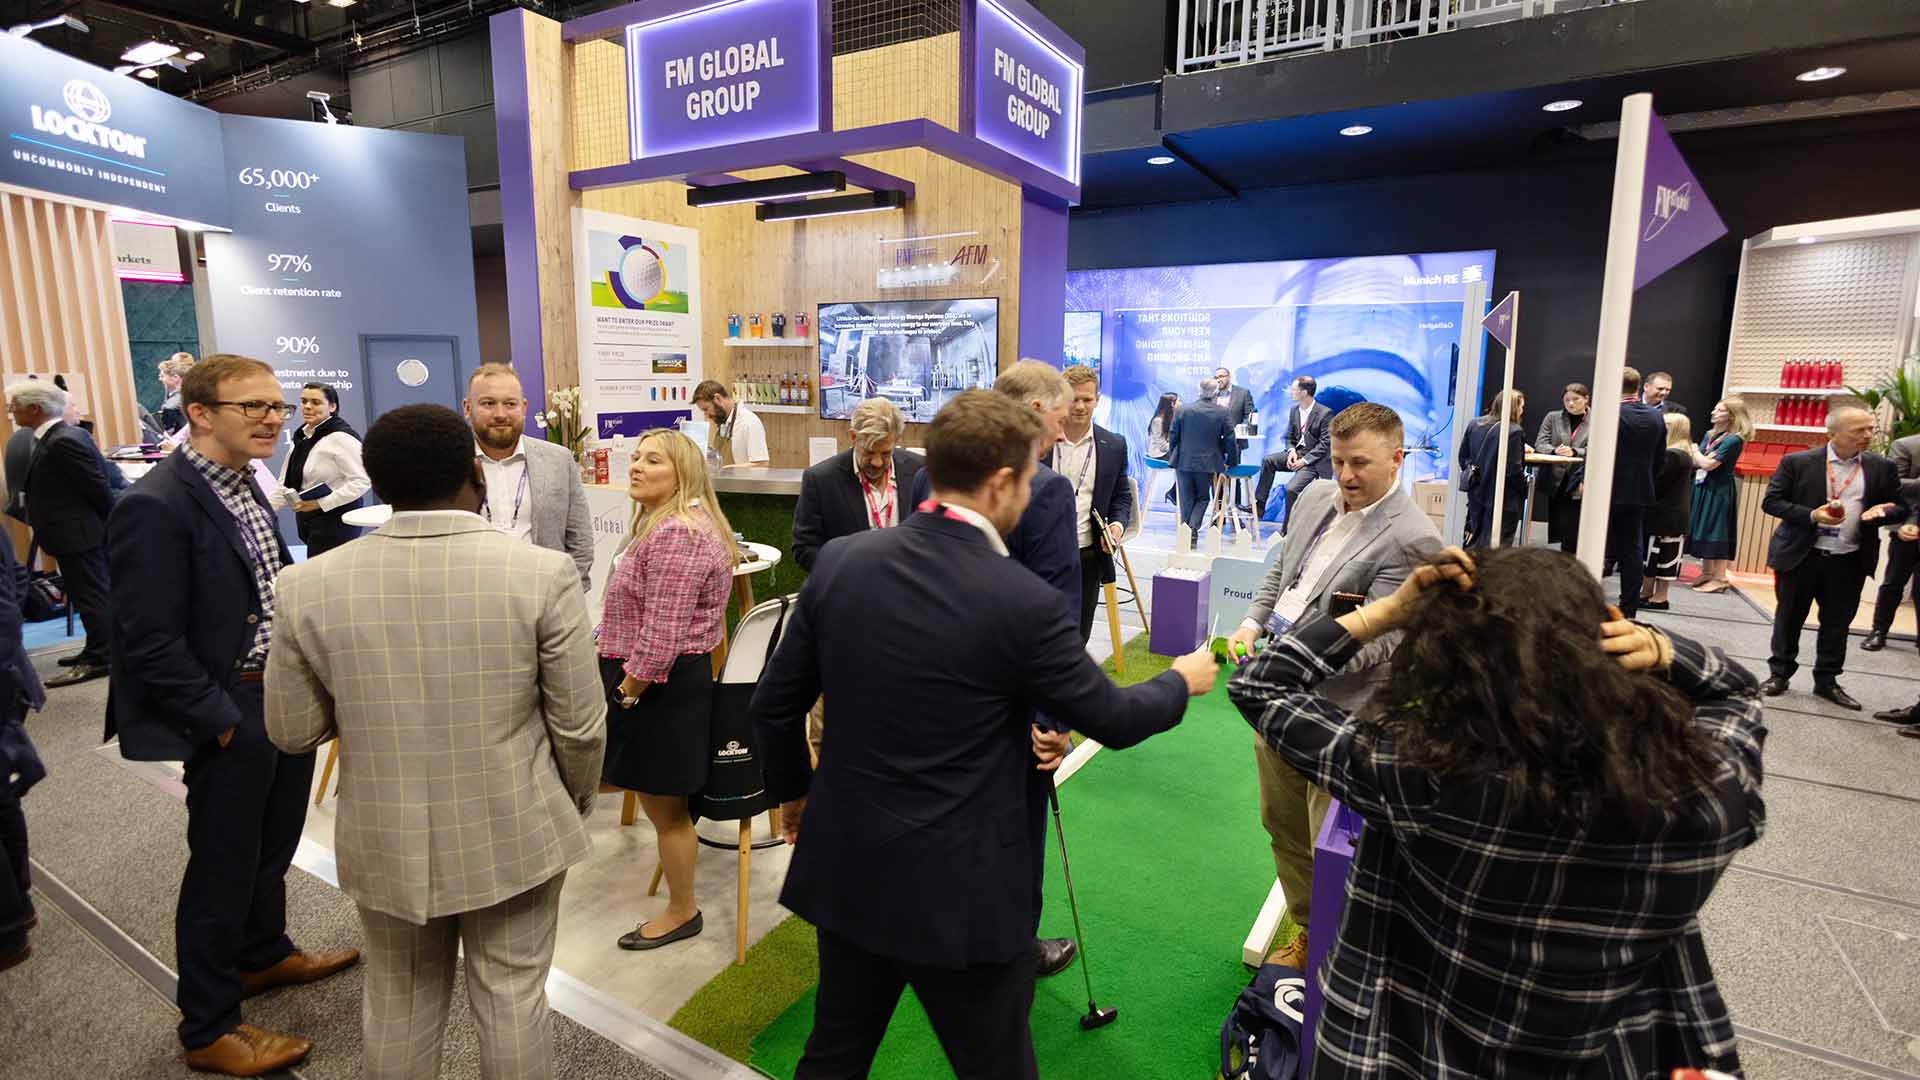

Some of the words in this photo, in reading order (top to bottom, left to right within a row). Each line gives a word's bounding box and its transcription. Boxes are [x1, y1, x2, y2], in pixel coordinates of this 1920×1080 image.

[665, 58, 694, 88] FM
[699, 37, 784, 83] GLOBAL
[994, 47, 1015, 86] FM
[1016, 63, 1062, 115] GLOBAL
[686, 80, 760, 121] GROUP
[1007, 94, 1050, 139] GROUP
[31, 105, 146, 158] LOCKTON
[13, 149, 94, 177] UNCOMMONLY
[98, 169, 167, 194] INDEPENDENT
[239, 167, 320, 190] 65,000+
[265, 202, 301, 214] Clients
[267, 253, 312, 273] 97%
[950, 244, 988, 266] AFM
[1403, 274, 1441, 285] Munich
[1443, 274, 1459, 285] RE
[240, 286, 272, 297] Client
[273, 286, 320, 297] retention
[321, 287, 342, 298] rate
[276, 336, 320, 354] 90%
[317, 367, 336, 378] due
[338, 369, 349, 378] to
[594, 516, 624, 535] Global
[1223, 587, 1253, 600] Proud
[718, 747, 749, 756] LOCKTON
